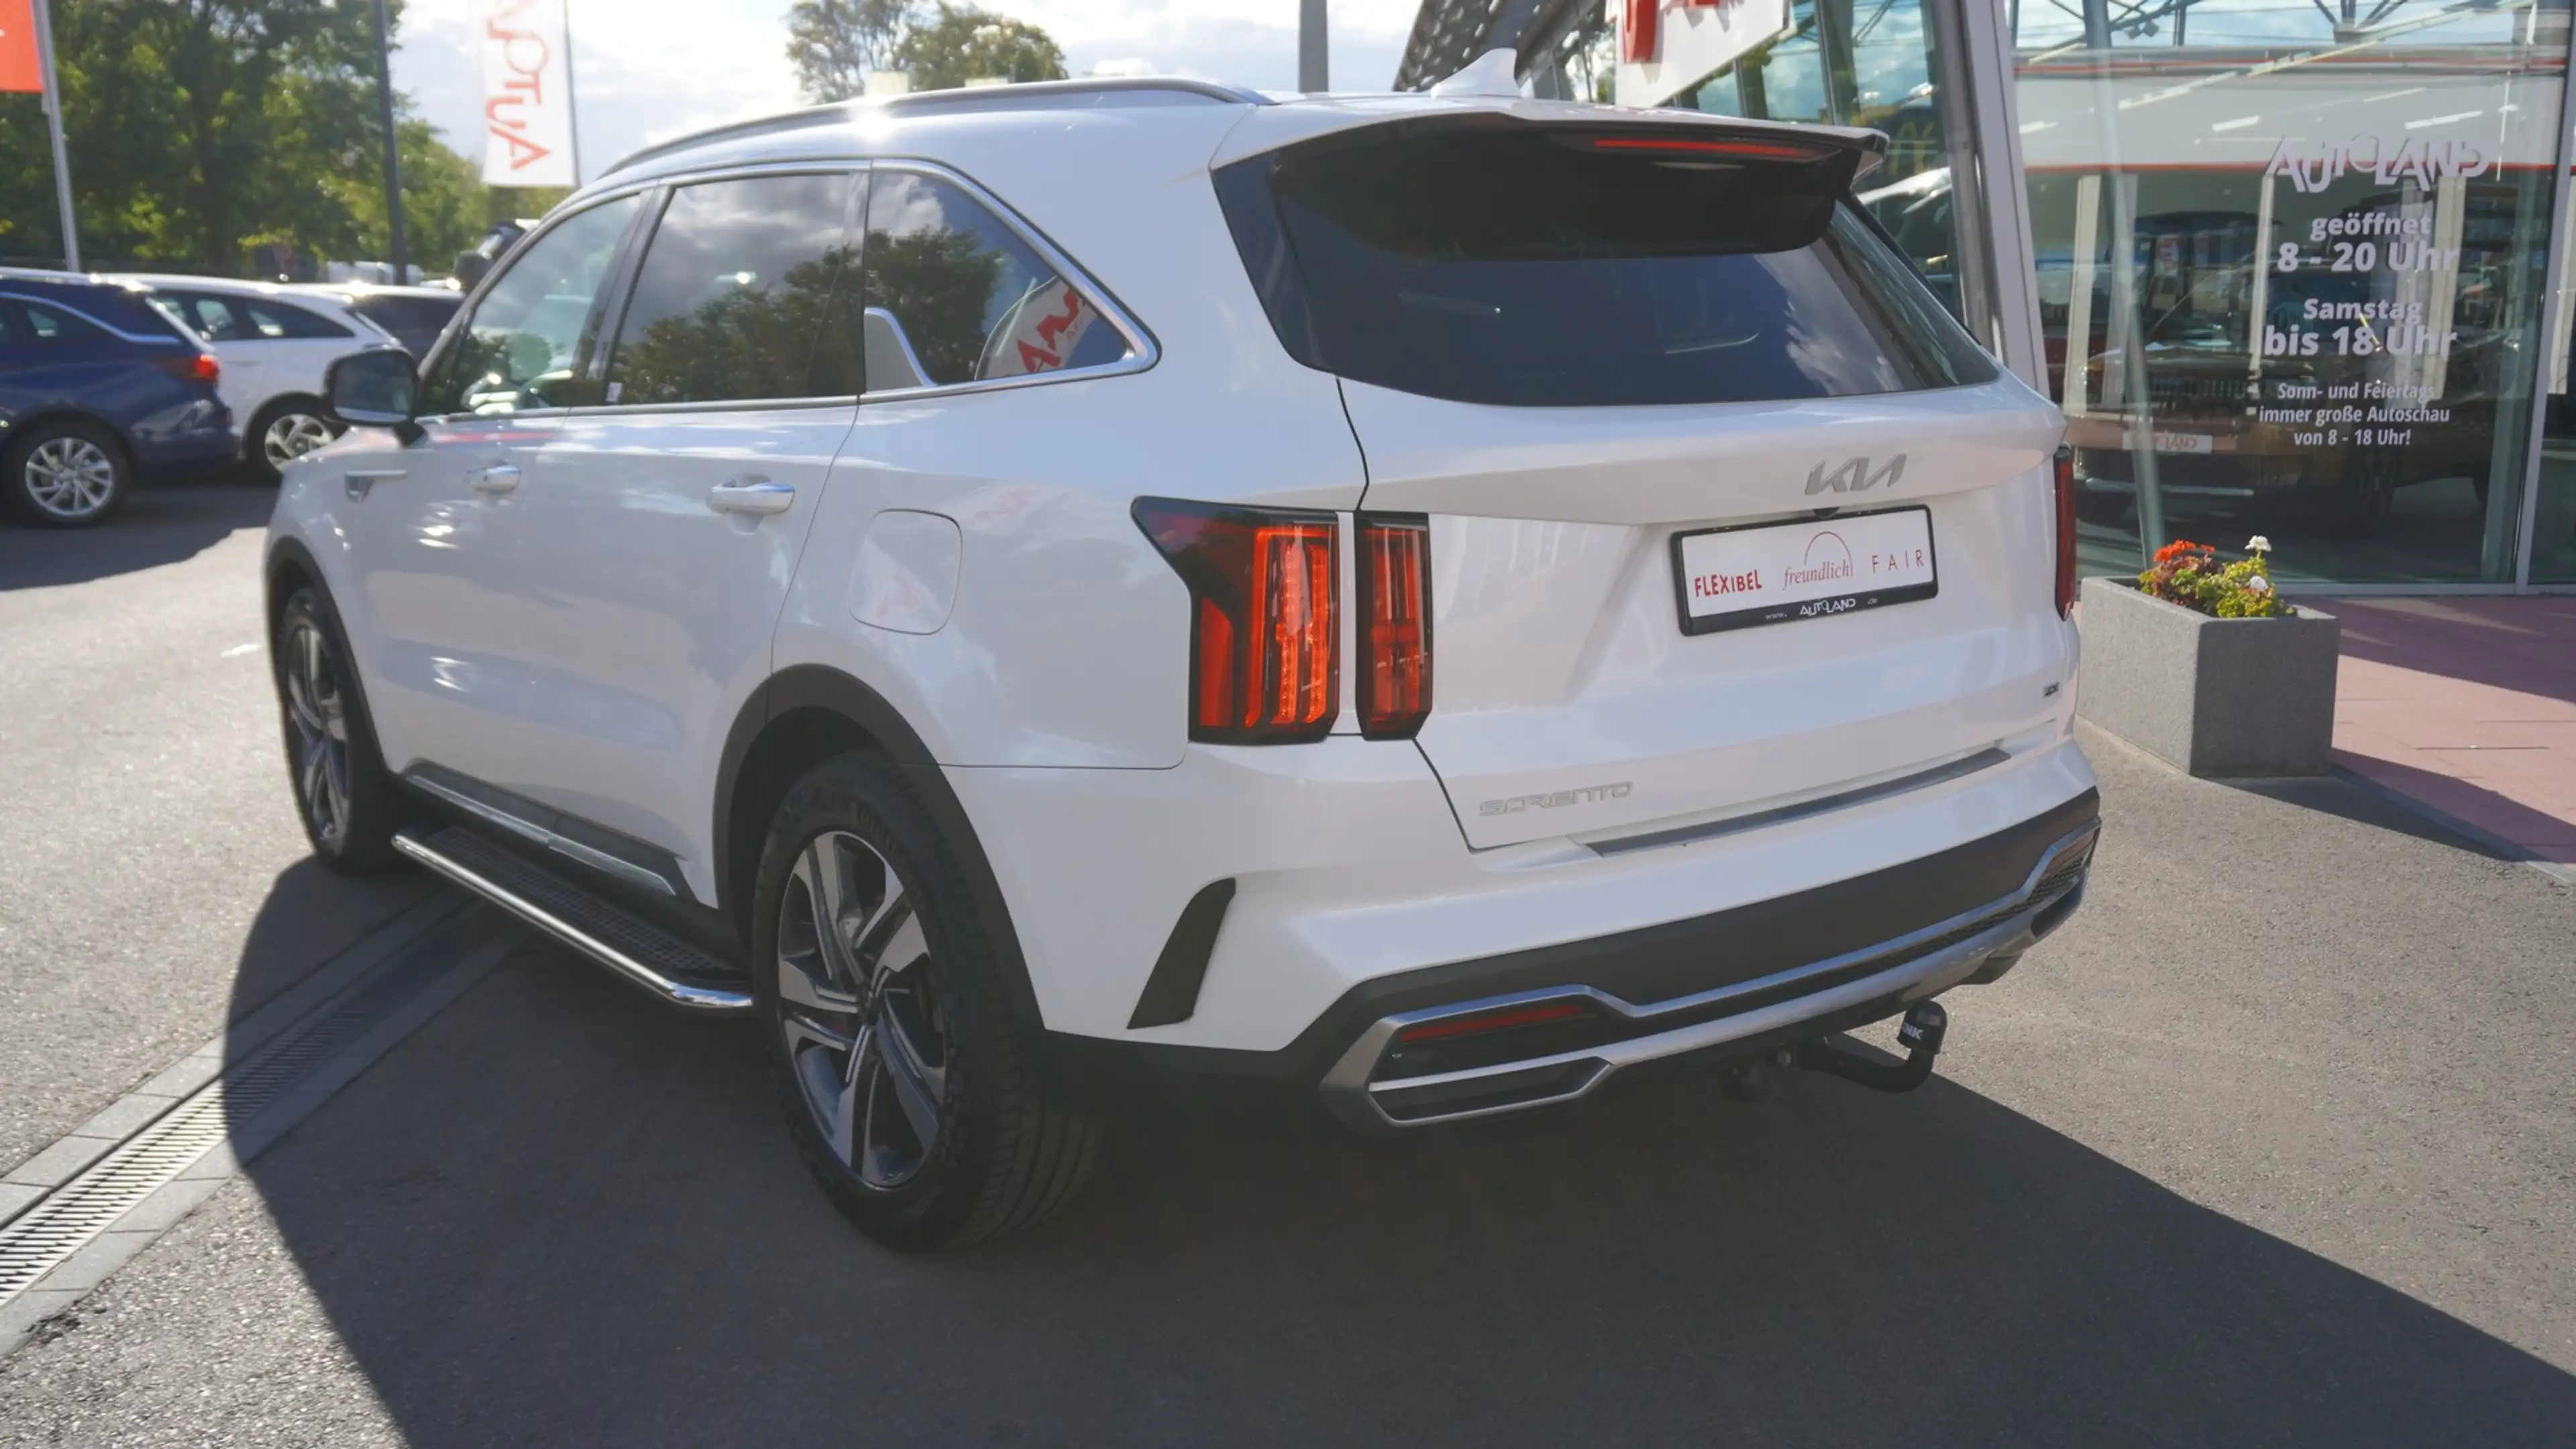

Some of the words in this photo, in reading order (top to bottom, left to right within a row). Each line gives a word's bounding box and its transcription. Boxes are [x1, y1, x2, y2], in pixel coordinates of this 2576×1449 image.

[2266, 133, 2489, 193] AUTOLAND
[2310, 213, 2432, 241] geöffnet
[2277, 242, 2299, 272] 8
[2331, 242, 2376, 272] 20
[2388, 241, 2460, 272] Uhr
[2304, 299, 2422, 325] Samstag
[2264, 325, 2320, 356] bis
[2332, 326, 2374, 356] 18
[2386, 325, 2457, 356] Uhr
[2277, 383, 2323, 399] Sonn-
[2328, 382, 2359, 399] und
[2364, 383, 2434, 404] Feiertags
[2259, 406, 2311, 423] immer
[2315, 406, 2363, 427] große
[2367, 406, 2450, 423] Autoschau
[2294, 432, 2322, 445] von
[2328, 431, 2337, 445] 8
[2355, 431, 2372, 445] 18
[2377, 429, 2411, 445] Uhr!
[1805, 453, 1907, 495] KIA
[1695, 570, 1762, 597] FLEXIBEL
[1782, 558, 1851, 591] freundlich
[1799, 598, 1856, 616] AUTOLAND
[1479, 781, 1633, 816] SORENTO
